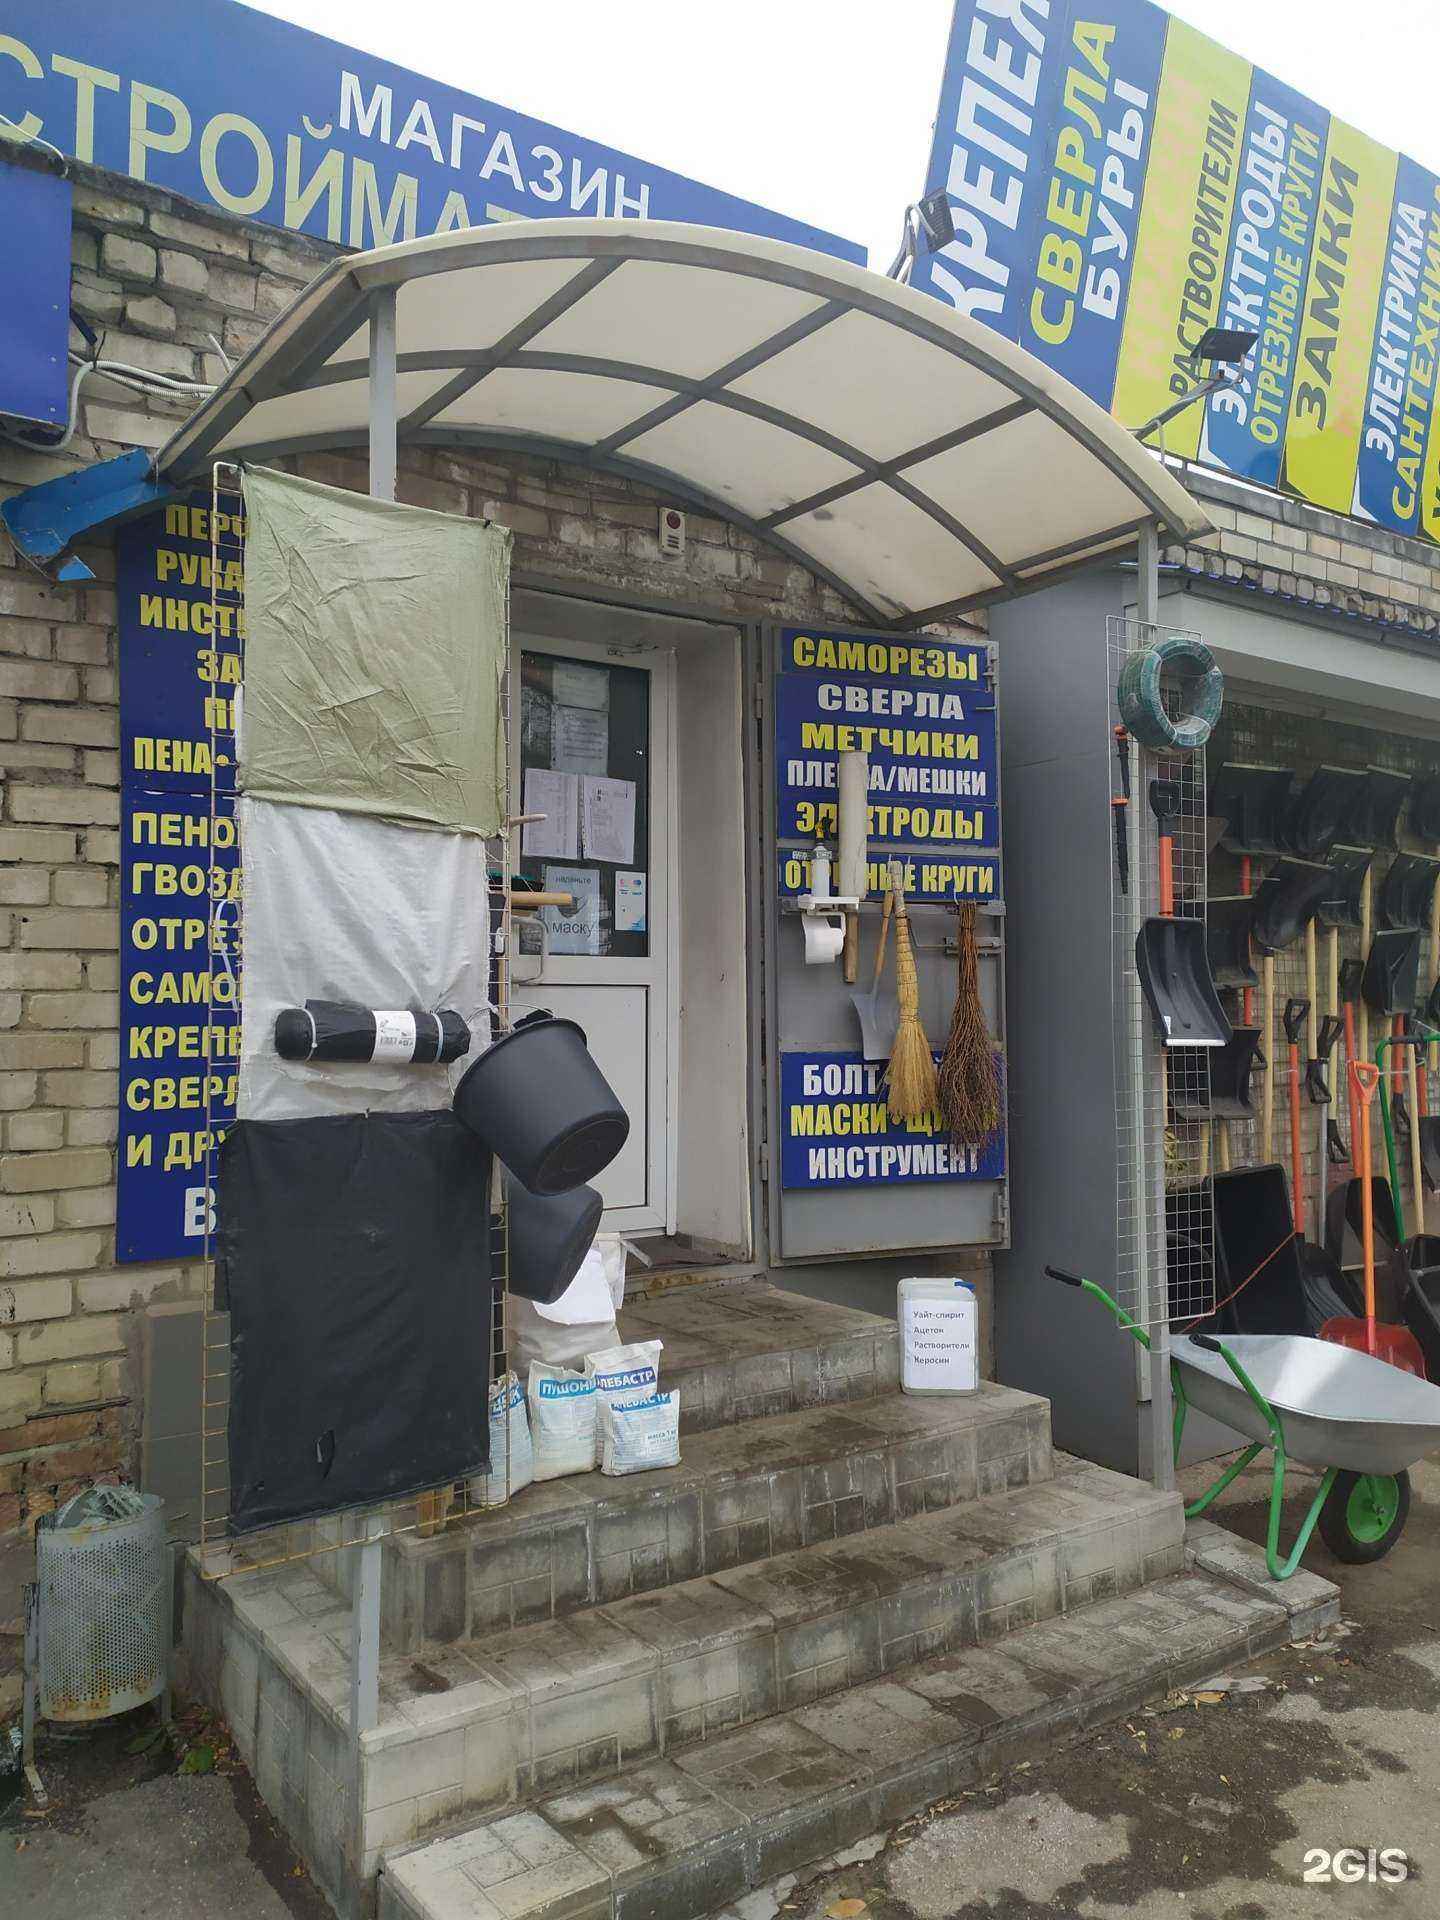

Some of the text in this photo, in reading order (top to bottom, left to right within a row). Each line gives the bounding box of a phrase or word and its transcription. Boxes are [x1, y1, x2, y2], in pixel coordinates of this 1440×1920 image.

[339, 70, 650, 220] МАГАЗИН
[1031, 20, 1116, 345] СВЕРЛА
[1083, 78, 1149, 320] БУРЫ
[1249, 122, 1320, 445] ОТРЕЗНЫЕ КРУГИ
[1296, 156, 1360, 431] ЗАМКИ
[1365, 202, 1427, 463] ЭЛЕКТРИКА
[793, 636, 978, 681] САМОРЕЗЫ
[817, 683, 965, 720] СВЕРЛА
[134, 737, 213, 775] ПЕНА
[801, 722, 979, 760] МЕТЧИКИ
[922, 864, 994, 894] КРУГИ
[552, 922, 594, 938] маску
[790, 1103, 888, 1137] МАСКИ
[126, 1134, 152, 1168] И
[808, 1142, 980, 1180] ИНСТРУМЕНТ
[913, 1310, 965, 1320] Уайт-спирит
[913, 1326, 944, 1335] Ацетон
[914, 1341, 970, 1351] Растворители
[914, 1355, 950, 1366] Керосин
